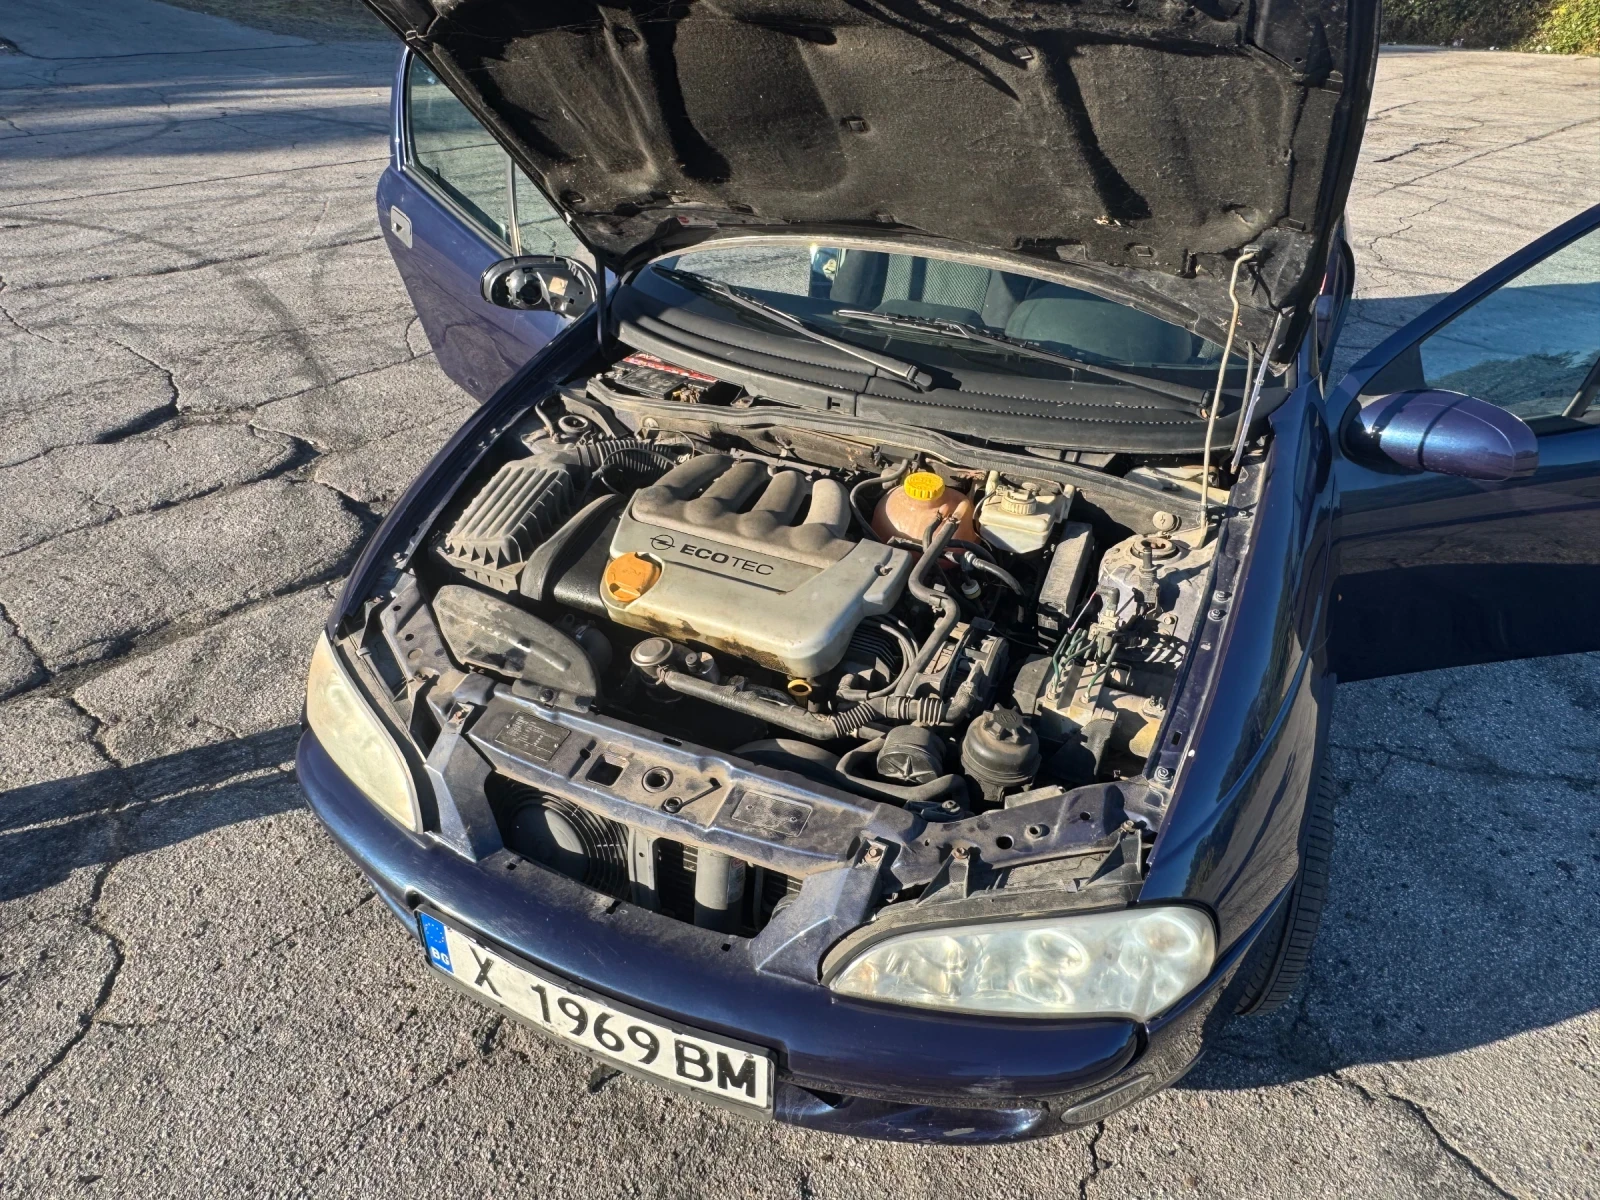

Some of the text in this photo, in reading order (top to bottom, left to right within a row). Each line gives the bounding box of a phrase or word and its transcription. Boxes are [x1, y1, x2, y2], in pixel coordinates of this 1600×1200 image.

[679, 543, 775, 576] ECOTEC
[430, 945, 450, 966] BG
[468, 944, 757, 1098] X 1969 BM
